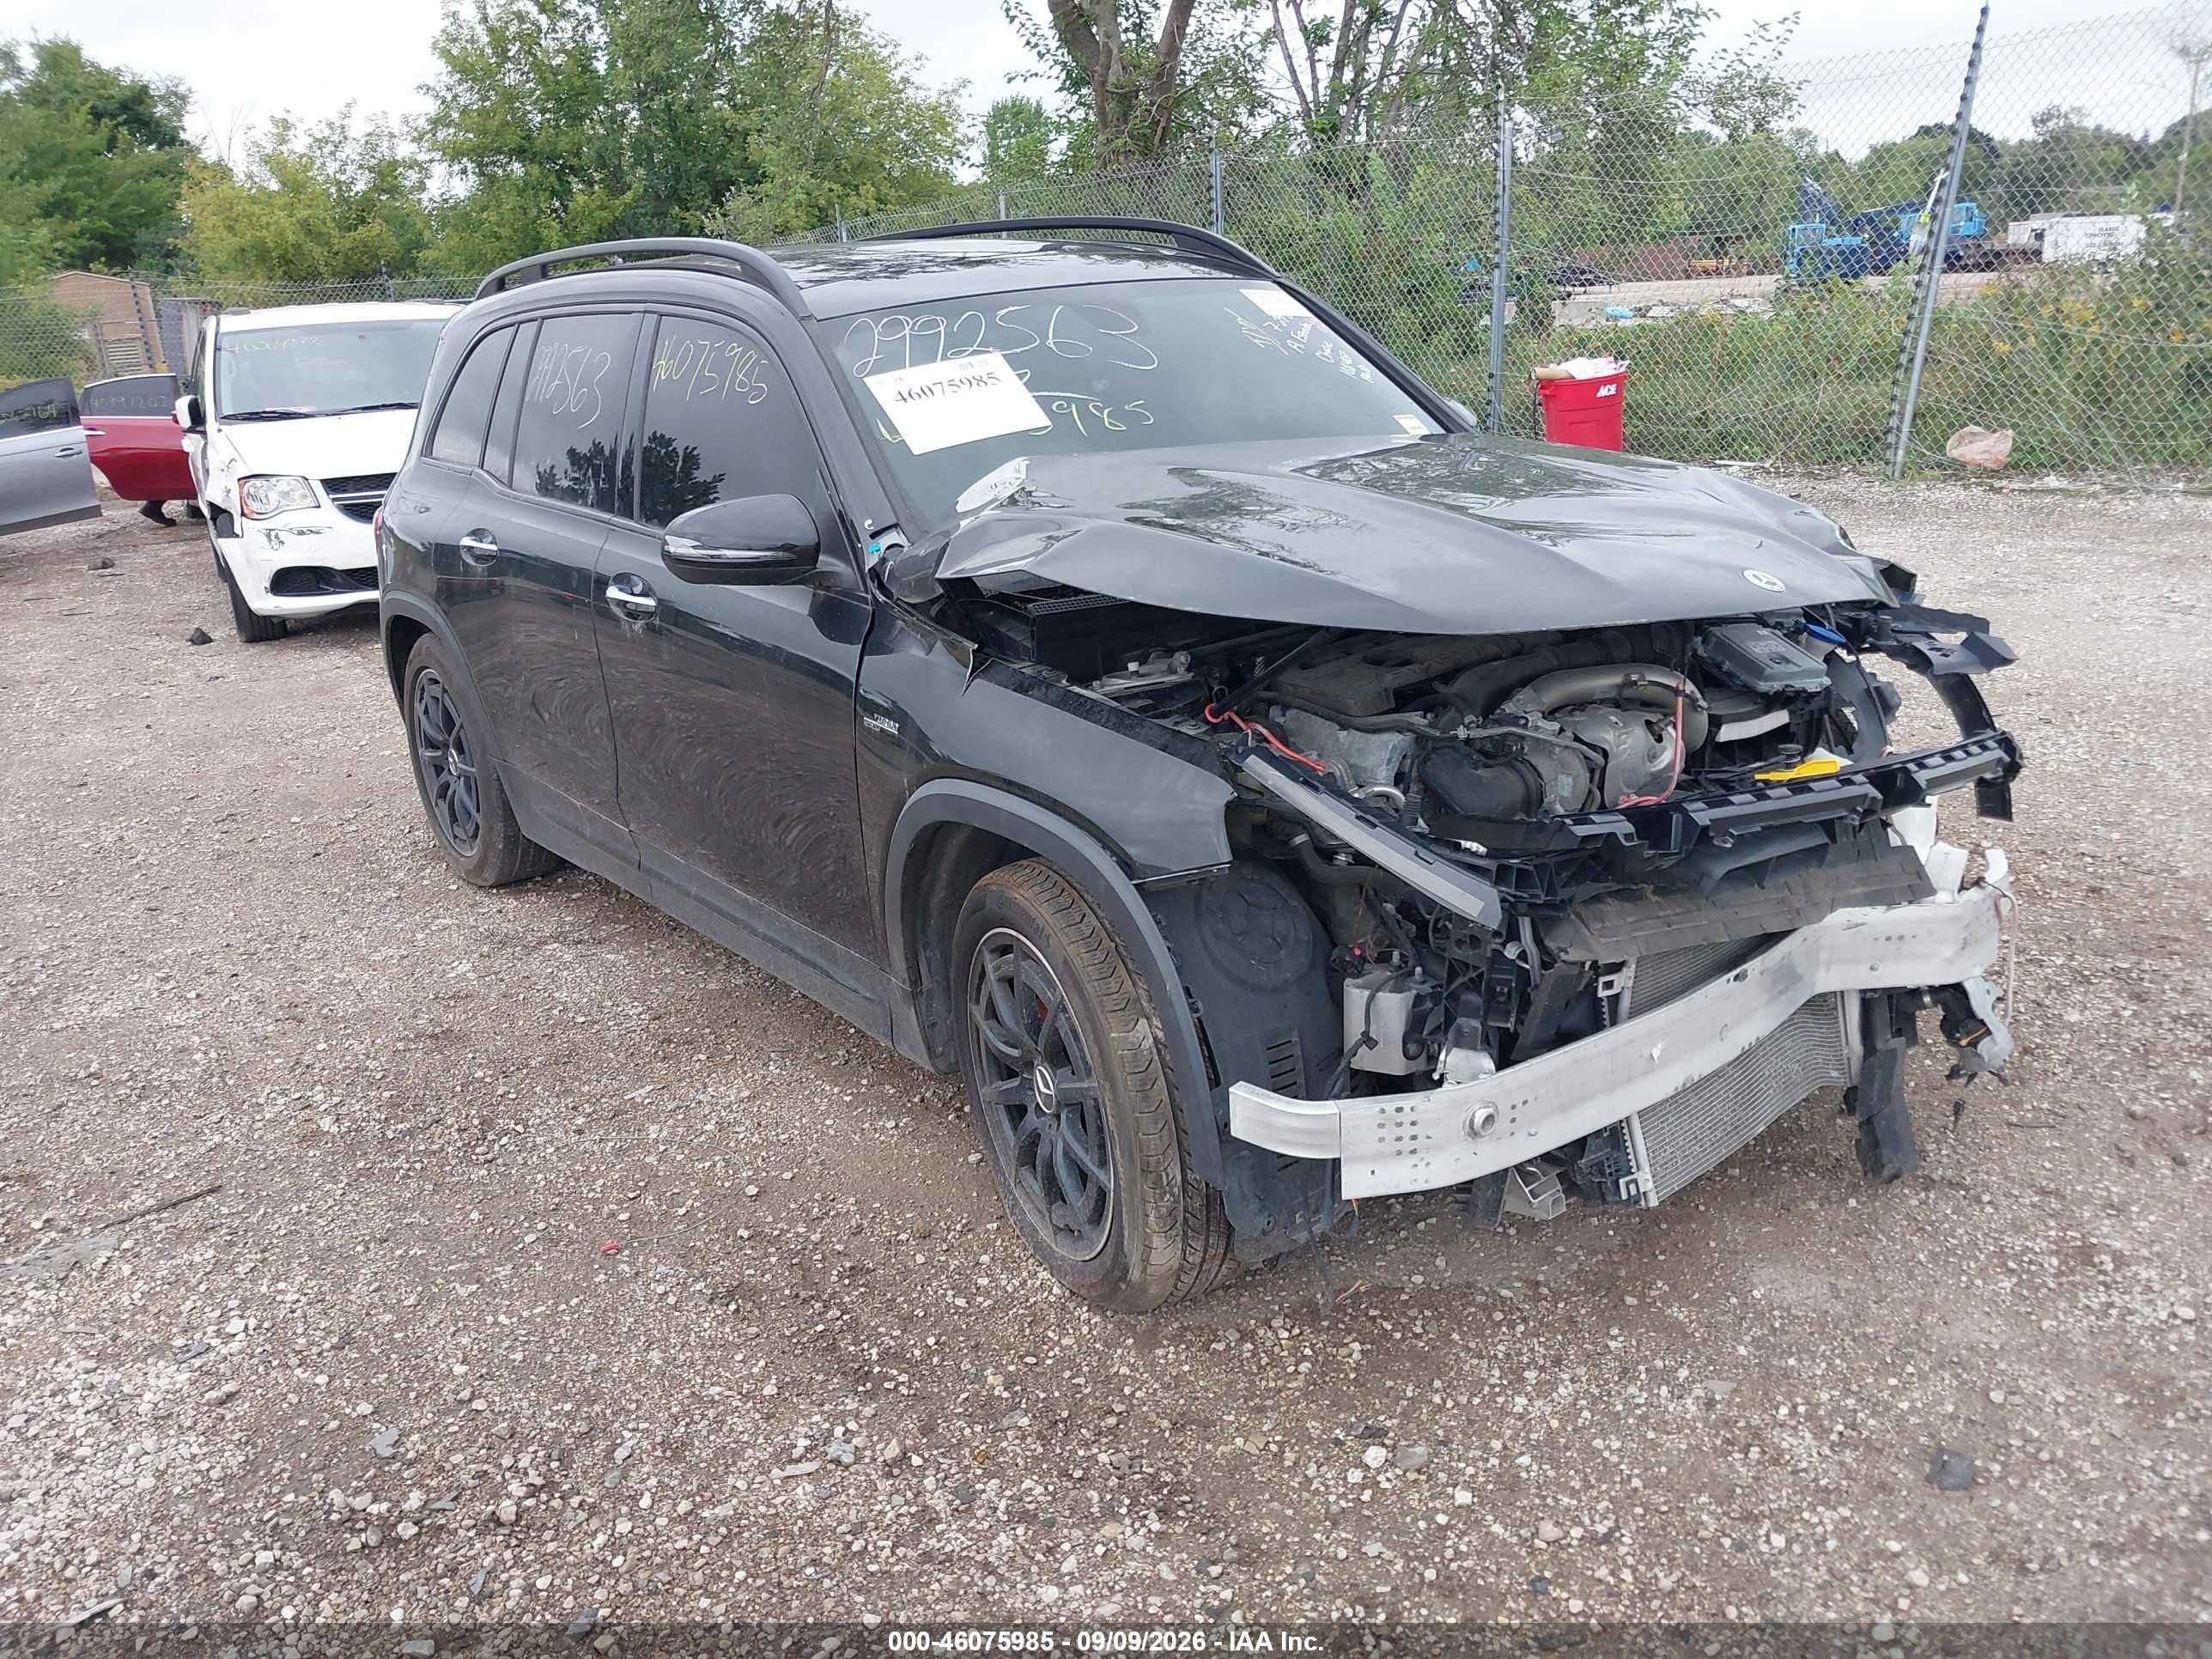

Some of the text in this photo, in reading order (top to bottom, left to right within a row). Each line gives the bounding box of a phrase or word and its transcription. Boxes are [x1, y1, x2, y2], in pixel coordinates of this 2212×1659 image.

[844, 304, 1158, 378] 2992563
[653, 334, 769, 404] 46075985
[893, 371, 1002, 404] 46075985
[1595, 383, 1618, 398] ACE
